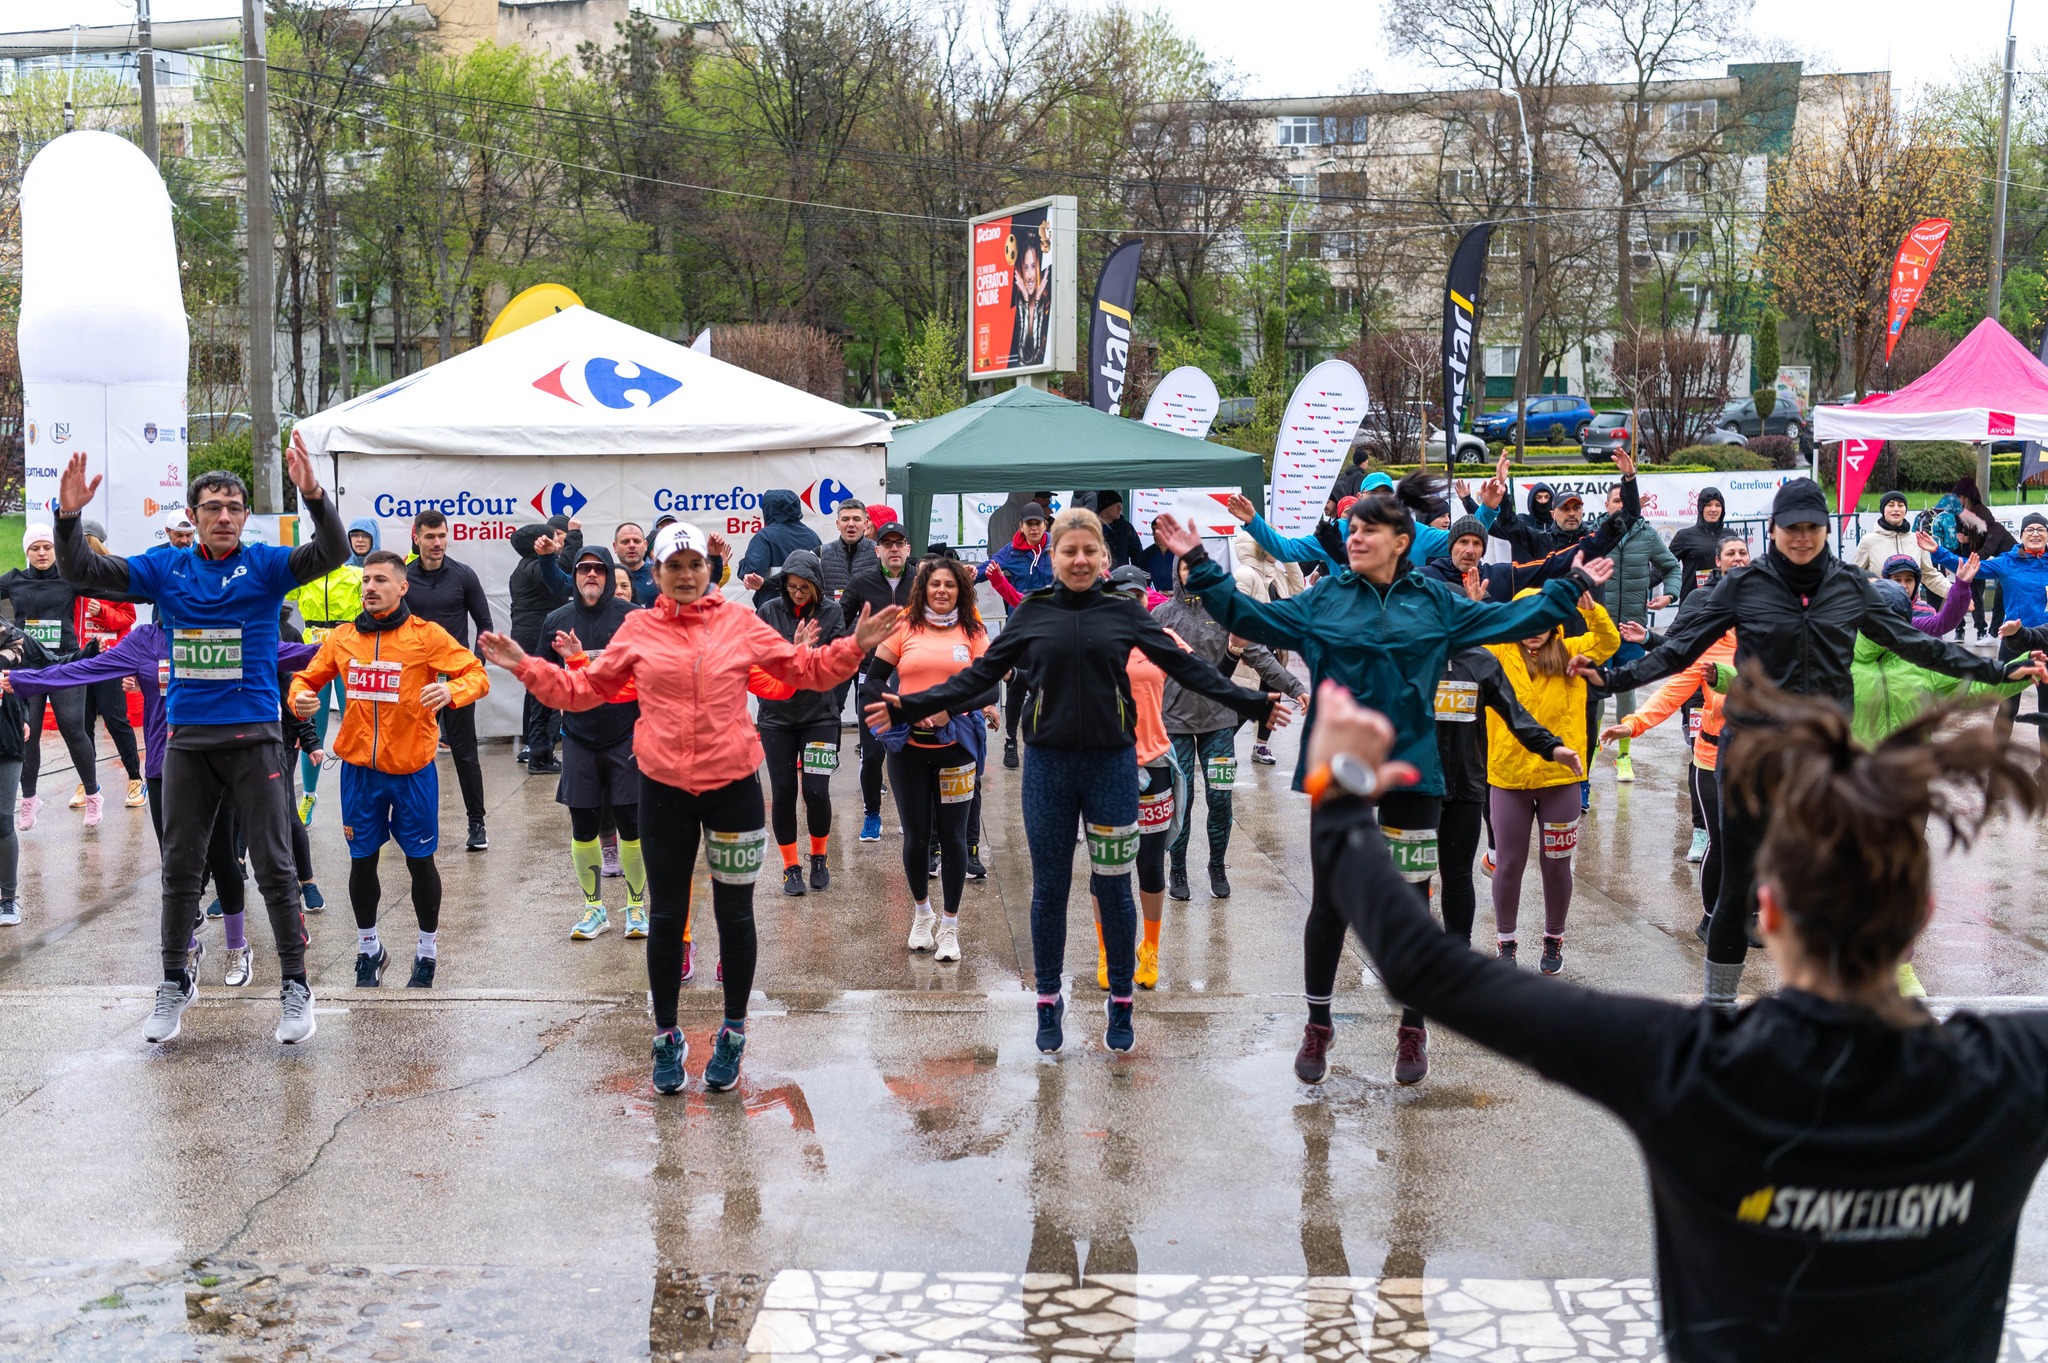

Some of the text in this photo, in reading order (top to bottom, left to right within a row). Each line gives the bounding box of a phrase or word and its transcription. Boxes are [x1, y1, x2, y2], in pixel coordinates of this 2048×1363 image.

[977, 227, 1001, 243] Betano
[976, 270, 1009, 291] OPERATOR
[976, 288, 999, 307] ONLINE
[1730, 480, 1773, 490] Carrefour
[374, 491, 518, 518] Carrefour
[654, 486, 765, 512] Carrefou
[453, 520, 517, 541] Brăila
[31, 628, 50, 639] 201
[187, 645, 226, 664] 107
[358, 672, 386, 688] 411
[1436, 693, 1466, 708] 712
[814, 752, 833, 765] 103
[950, 775, 974, 791] 718
[1145, 802, 1170, 822] 335
[1556, 829, 1578, 847] 409
[722, 848, 757, 868] 109
[1098, 838, 1132, 860] 115
